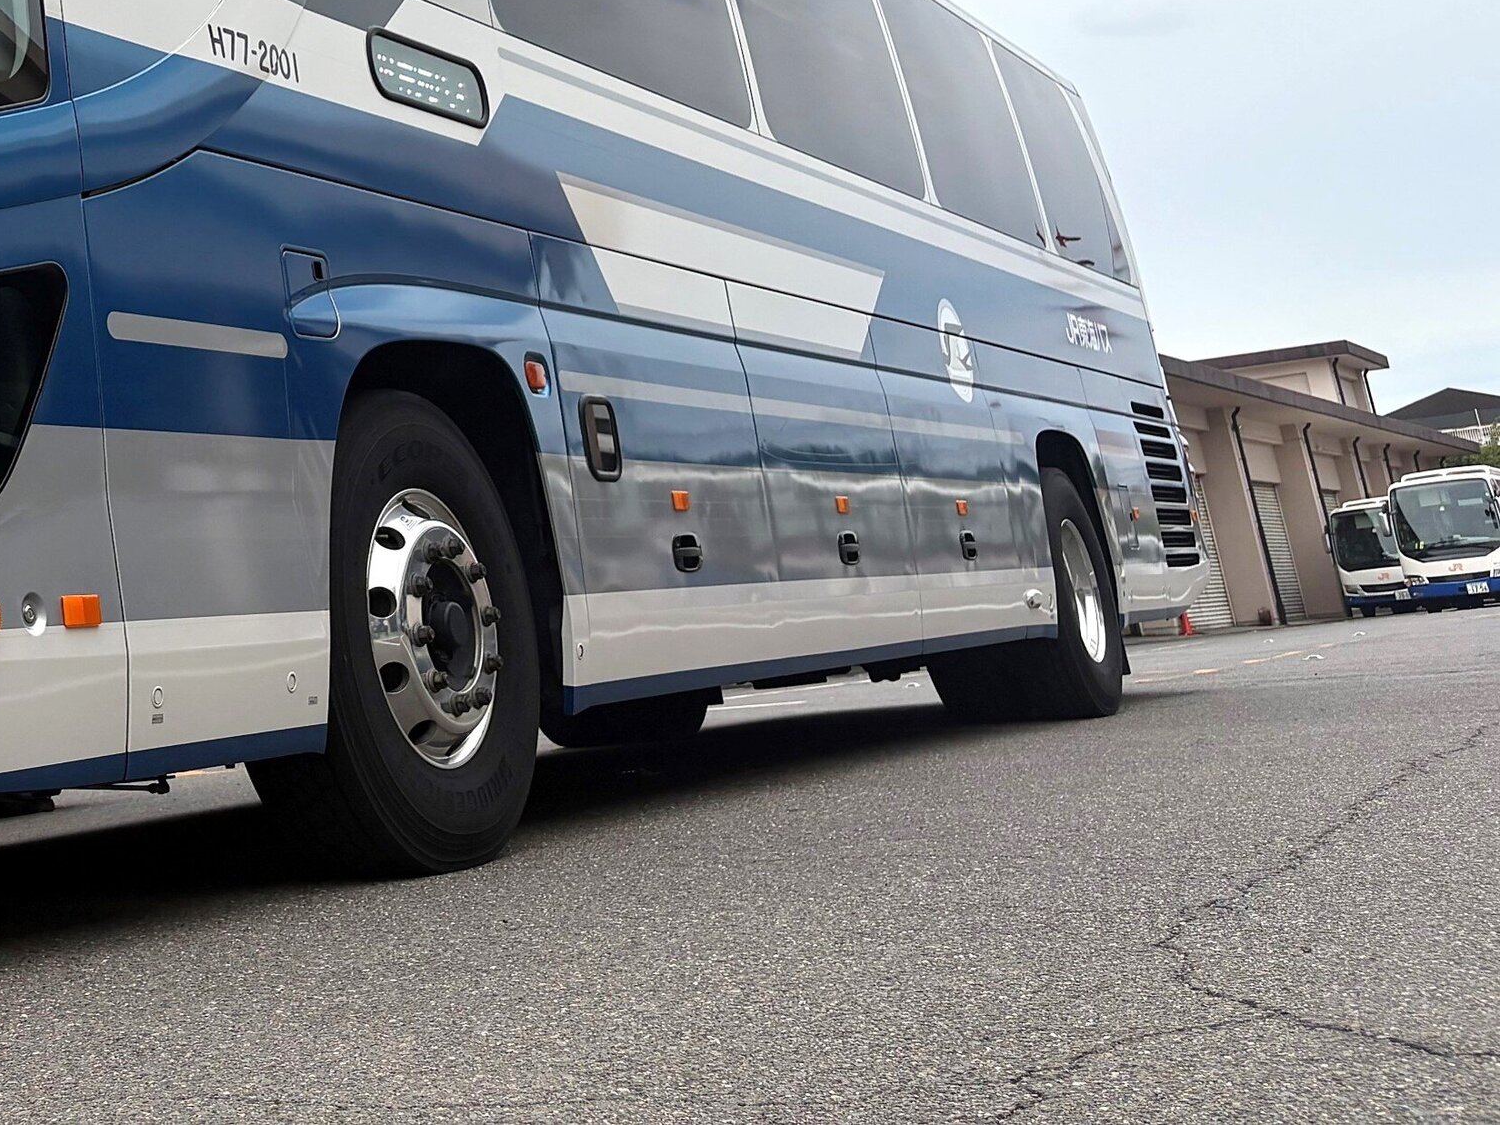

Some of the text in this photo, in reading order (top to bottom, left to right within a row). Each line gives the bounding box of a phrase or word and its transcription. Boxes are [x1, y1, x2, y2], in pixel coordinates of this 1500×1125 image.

[207, 23, 299, 83] H77-2001
[1065, 311, 1113, 354] JR東海バス
[1377, 572, 1390, 581] JR
[1448, 563, 1464, 572] JR
